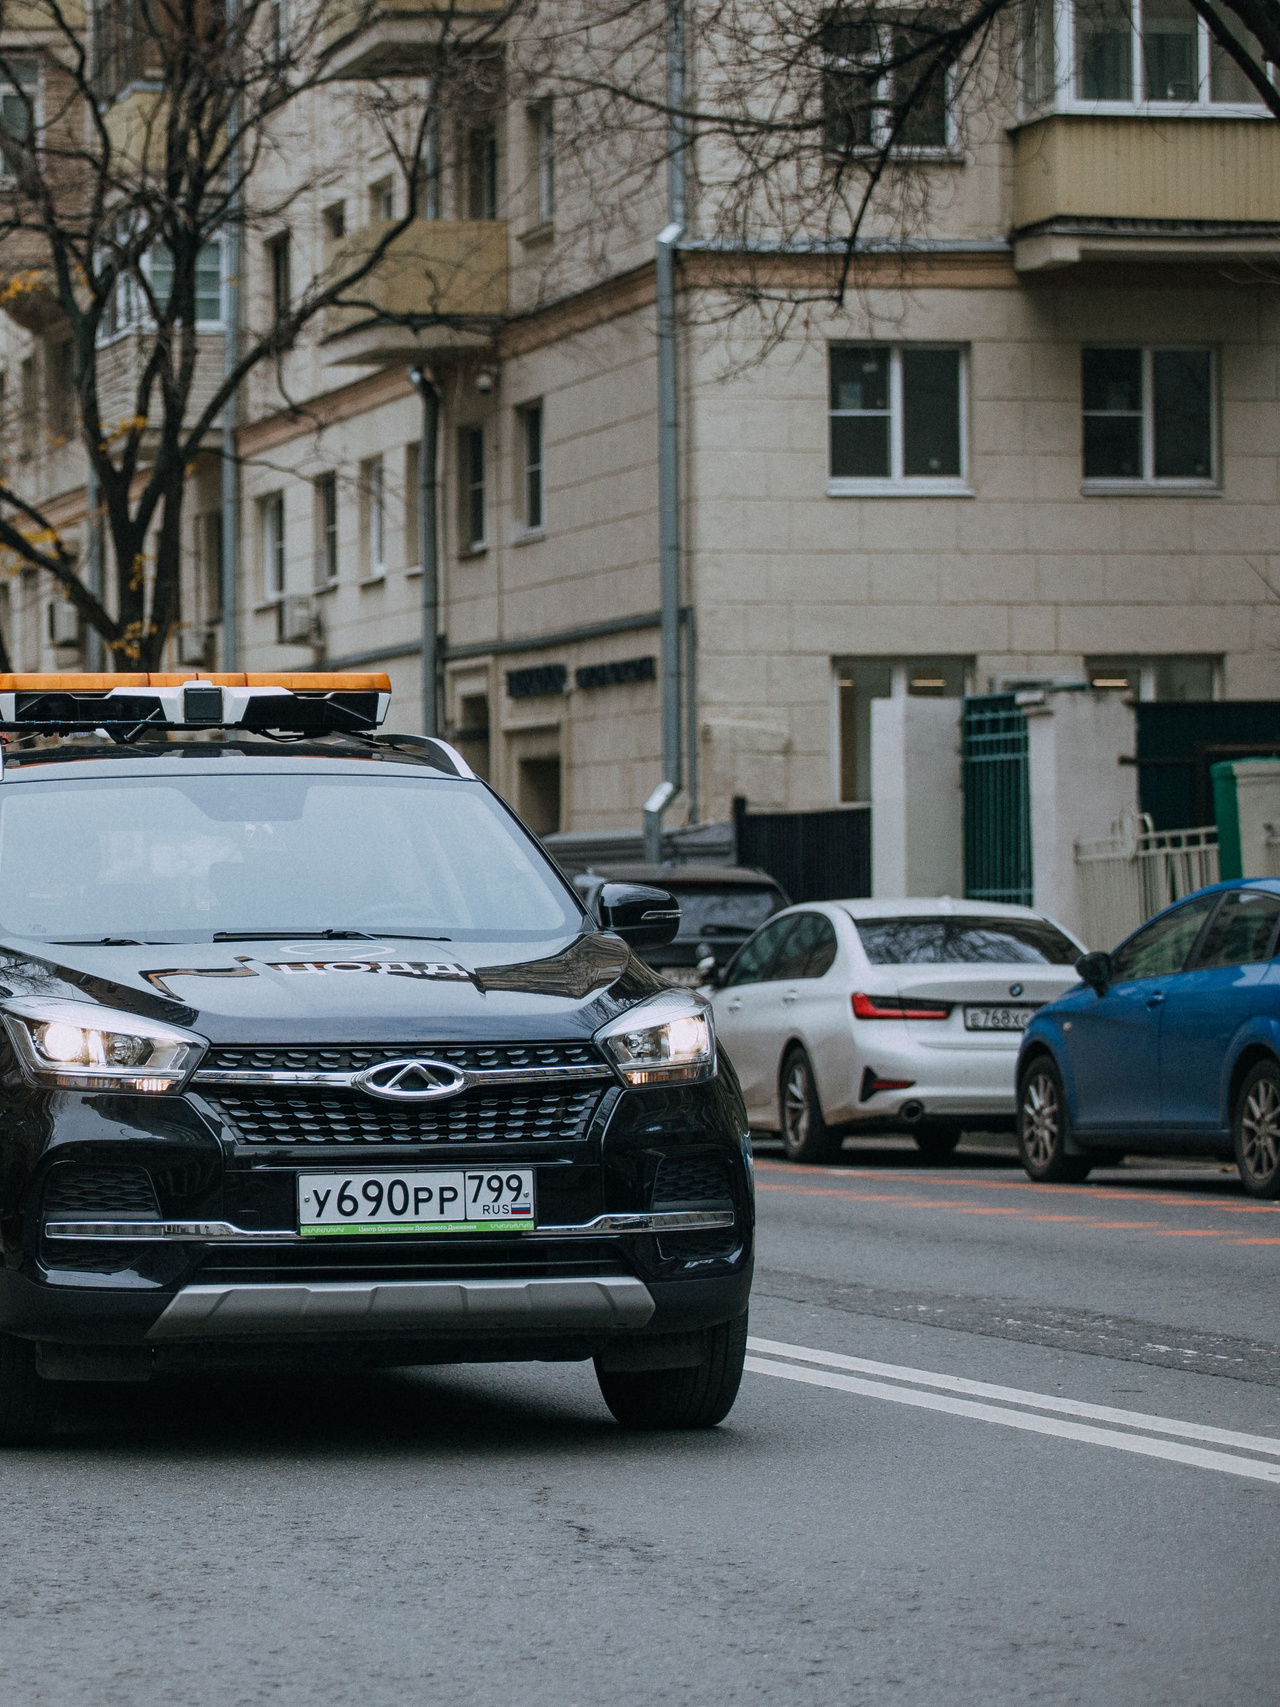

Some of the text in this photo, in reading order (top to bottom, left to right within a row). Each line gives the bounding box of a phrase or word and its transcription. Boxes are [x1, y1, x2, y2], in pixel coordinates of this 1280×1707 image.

[277, 962, 469, 977] ЦОДД
[312, 1173, 523, 1218] У690РР 799
[482, 1204, 510, 1215] RUS
[377, 1225, 414, 1233] Организации
